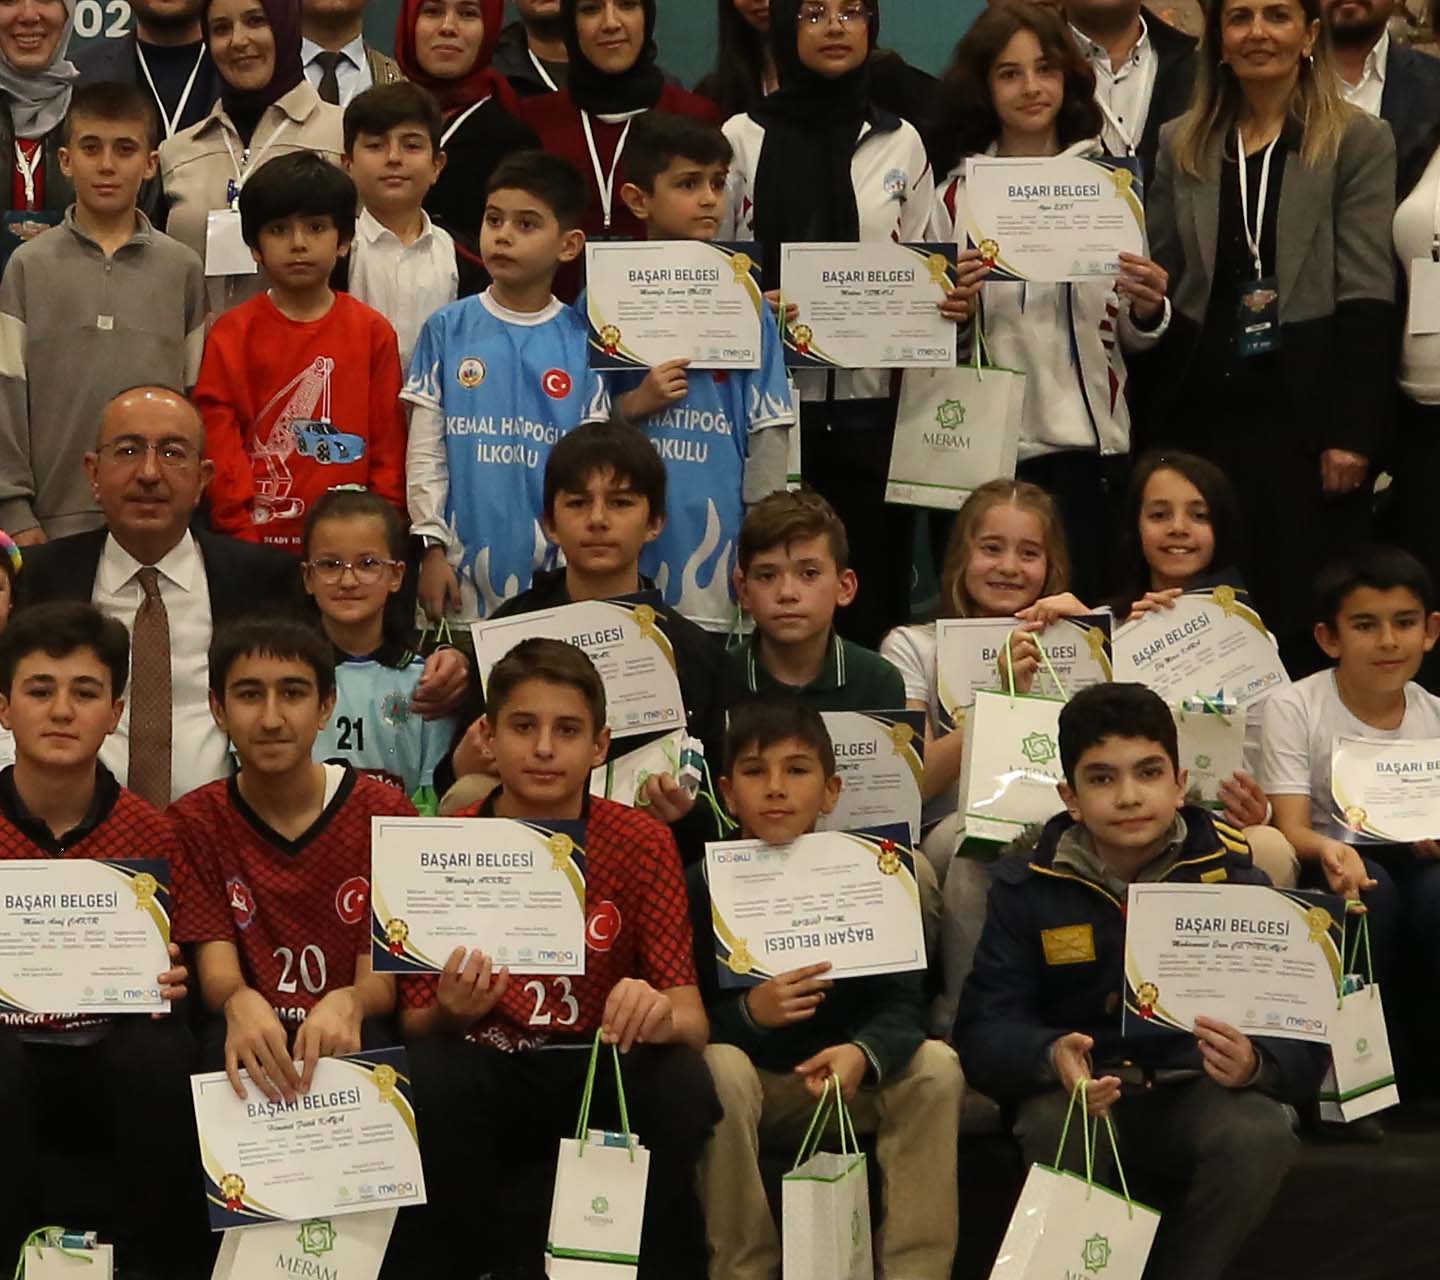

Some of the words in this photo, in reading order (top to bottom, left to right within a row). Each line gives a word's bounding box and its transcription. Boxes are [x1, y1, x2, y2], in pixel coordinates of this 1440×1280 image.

[1007, 184, 1051, 199] BAŞARI
[1053, 181, 1101, 198] BELGESİ
[628, 269, 672, 284] BAŞARI
[674, 267, 720, 282] BELGESİ
[822, 270, 865, 285] BAŞARI
[867, 268, 916, 283] BELGESİ
[446, 416, 497, 437] KEMAL
[923, 431, 971, 449] MERAM
[1130, 638, 1168, 667] BAŞARI
[1165, 613, 1211, 646] BELGESİ
[336, 715, 365, 751] 21
[834, 739, 879, 757] ELGESİ
[1375, 761, 1424, 776] BAŞARI
[420, 852, 472, 870] BAŞARI
[475, 850, 534, 869] BELGESİ
[4, 894, 57, 912] BAŞARI
[60, 891, 119, 909] BELGESİ
[1174, 917, 1227, 935] BAŞARI
[1230, 918, 1291, 937] BELGESİ
[272, 943, 329, 995] 20
[523, 975, 580, 1027] 23
[303, 1086, 362, 1112] BELGESİ
